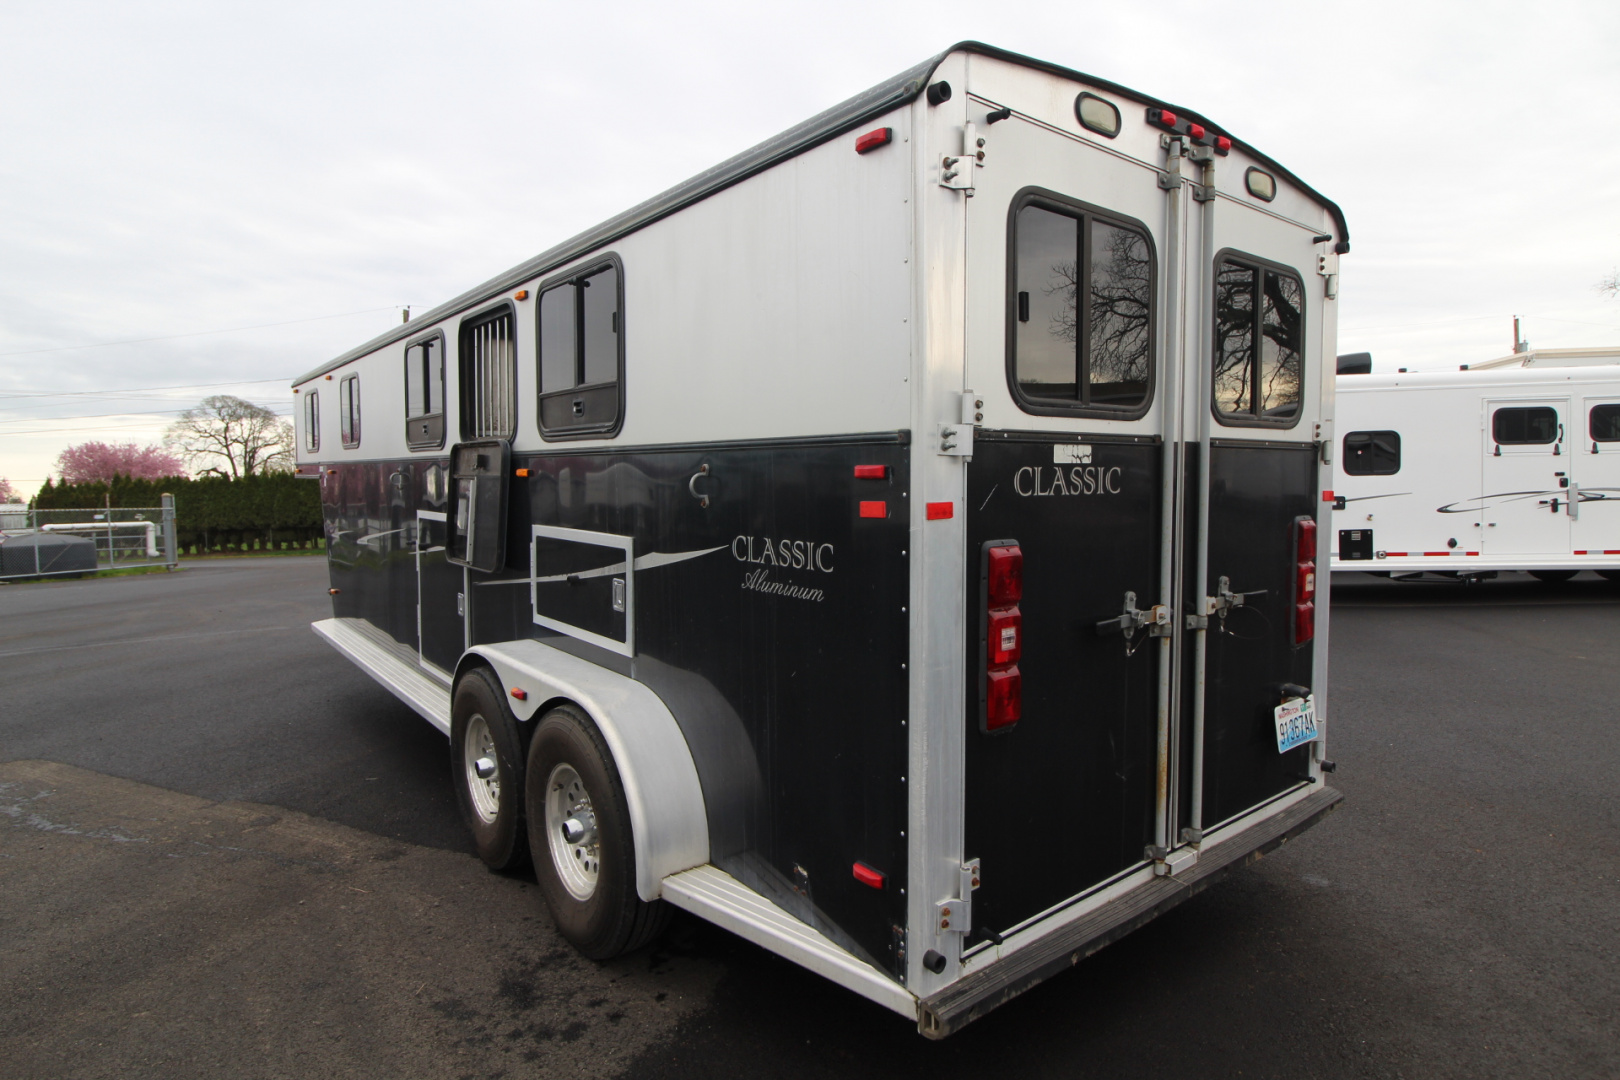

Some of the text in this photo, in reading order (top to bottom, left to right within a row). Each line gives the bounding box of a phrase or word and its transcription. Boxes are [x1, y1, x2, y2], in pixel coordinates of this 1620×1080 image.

[1014, 466, 1121, 497] CLASSIC
[732, 535, 834, 573] CLASSIC
[741, 568, 824, 602] Aluminum
